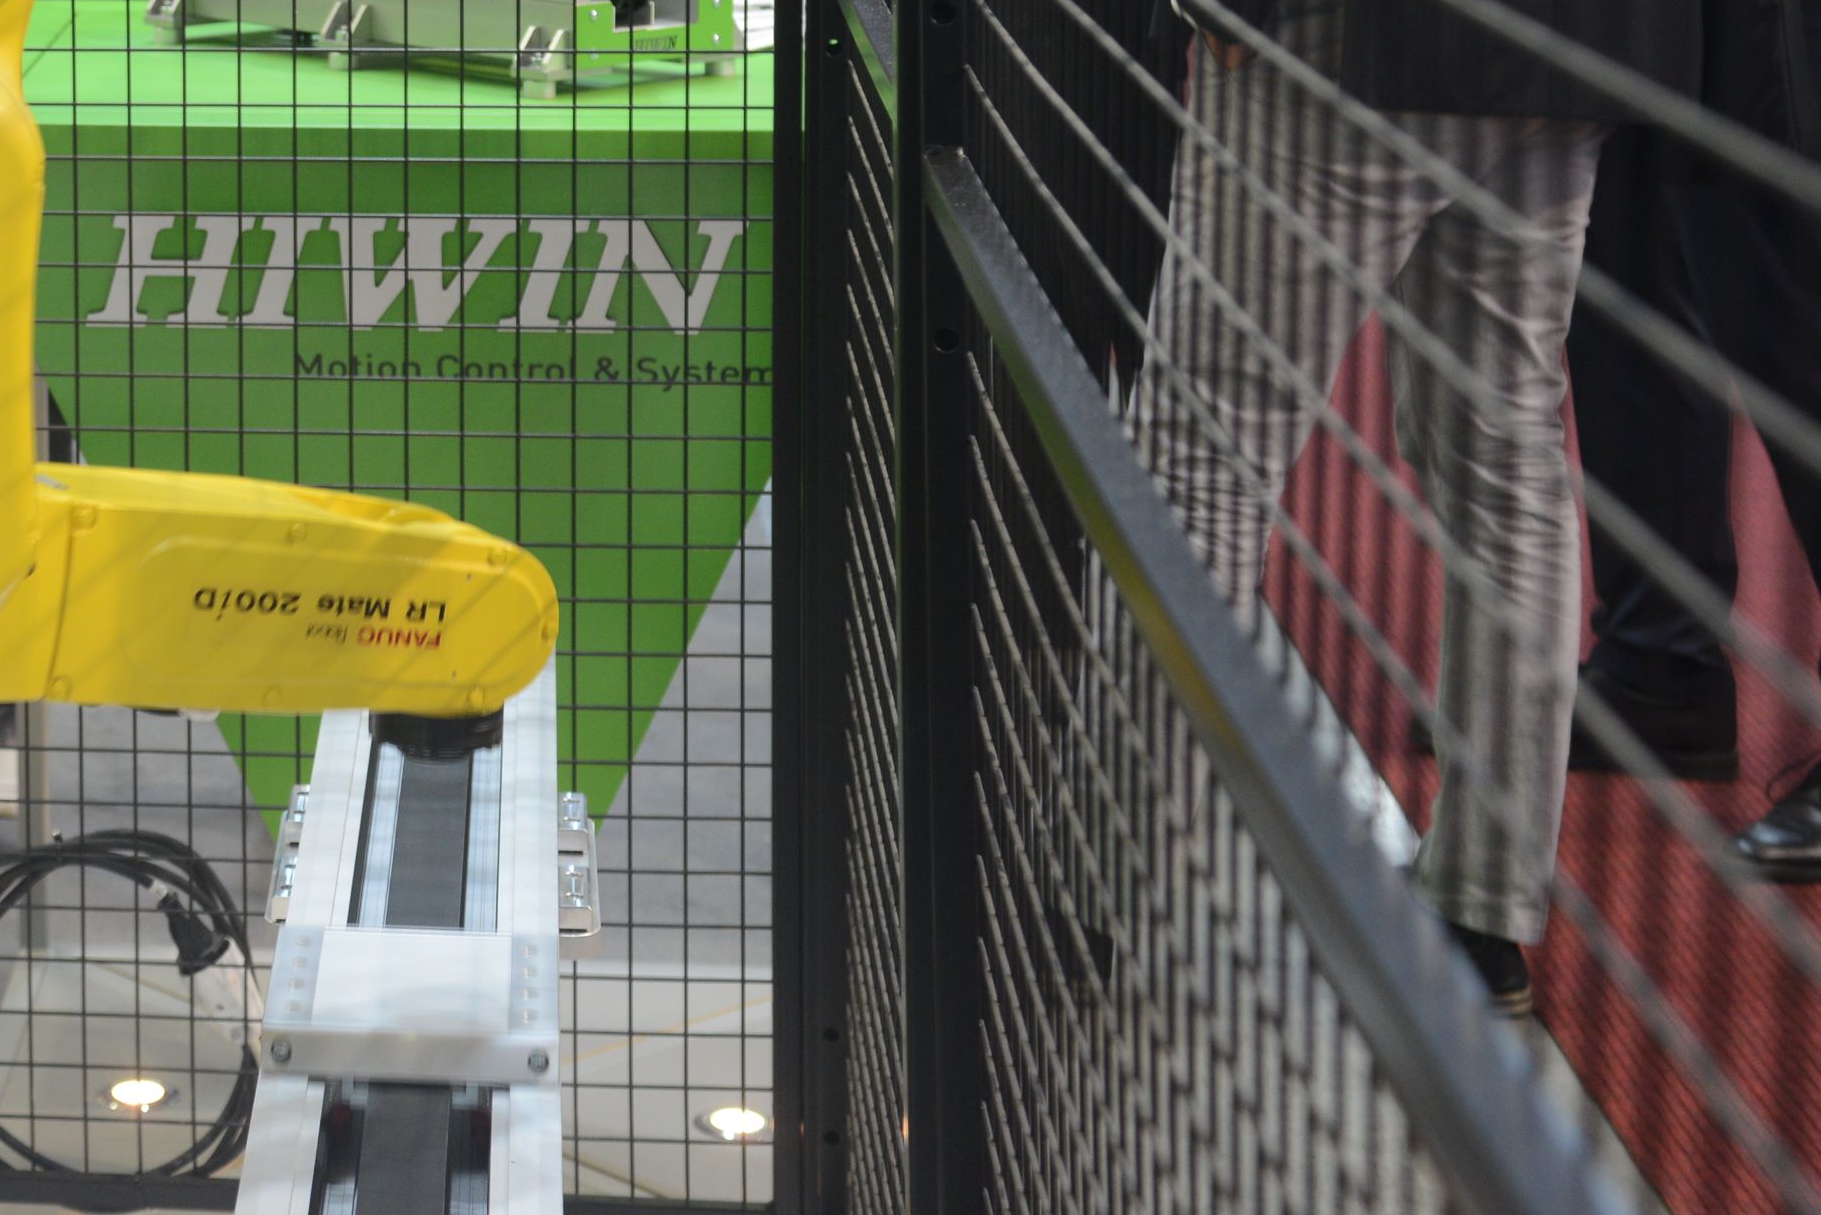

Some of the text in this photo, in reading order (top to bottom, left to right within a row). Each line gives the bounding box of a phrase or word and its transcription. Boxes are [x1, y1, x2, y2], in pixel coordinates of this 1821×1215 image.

[86, 215, 748, 334] HIWIN
[295, 353, 421, 379] Motion
[437, 355, 577, 381] Control
[594, 357, 620, 383] &
[317, 593, 391, 620] Mate
[405, 601, 446, 623] LR
[357, 625, 441, 649] FANUC
